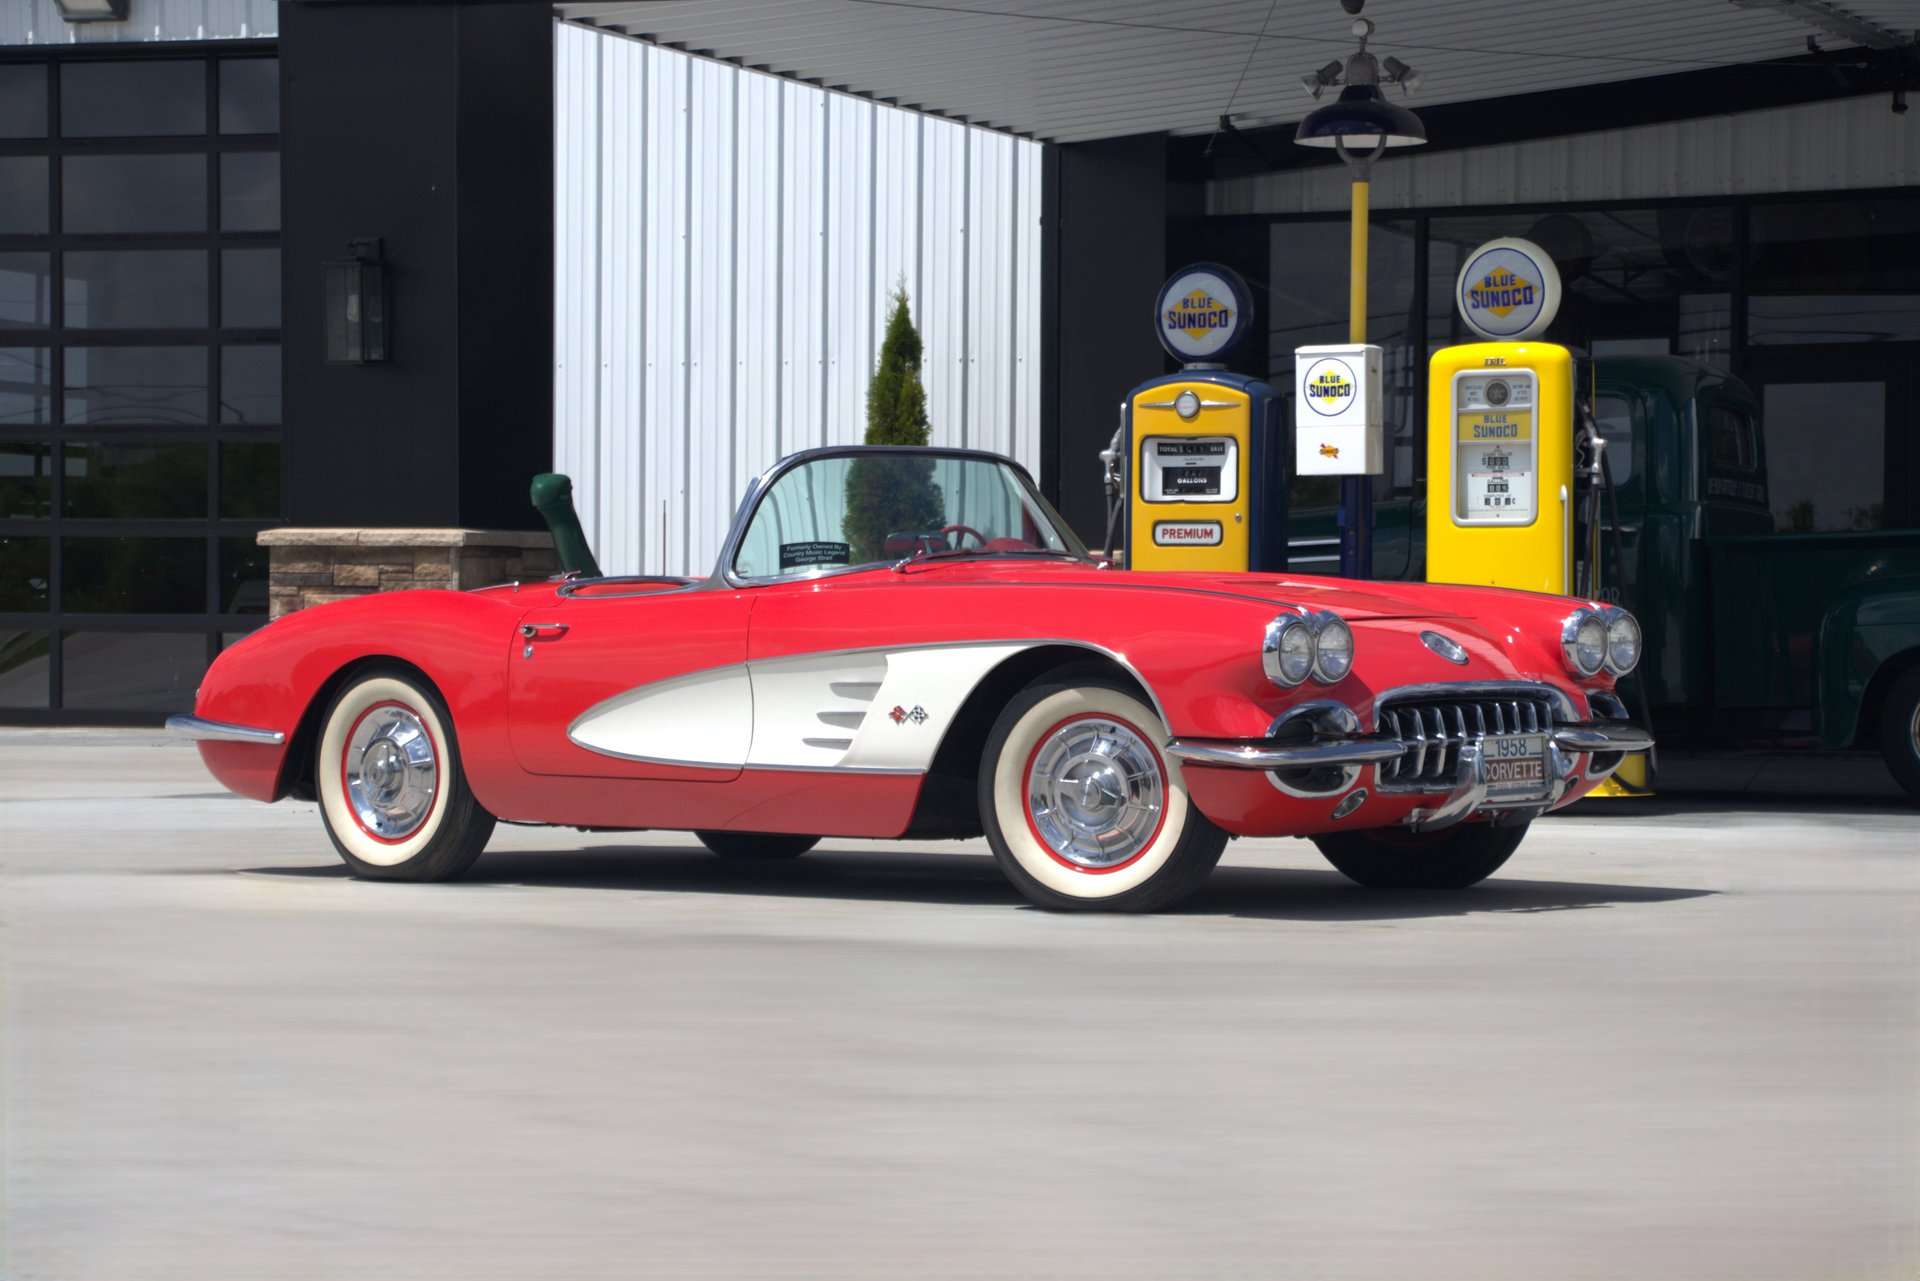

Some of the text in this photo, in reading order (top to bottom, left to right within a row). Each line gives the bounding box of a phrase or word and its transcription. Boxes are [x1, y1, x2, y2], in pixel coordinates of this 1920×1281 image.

[1484, 274, 1516, 287] BLUE
[1182, 297, 1213, 309] BLUE
[1470, 286, 1534, 309] SUNOCO
[1168, 309, 1228, 329] SUNOCO
[1319, 375, 1341, 384] BLUE
[1309, 383, 1351, 398] SUNOCO
[1483, 415, 1508, 424] BLUE
[1473, 424, 1518, 438] SUNOCO
[1162, 528, 1213, 540] PREMIUM
[1496, 738, 1527, 757] 1958
